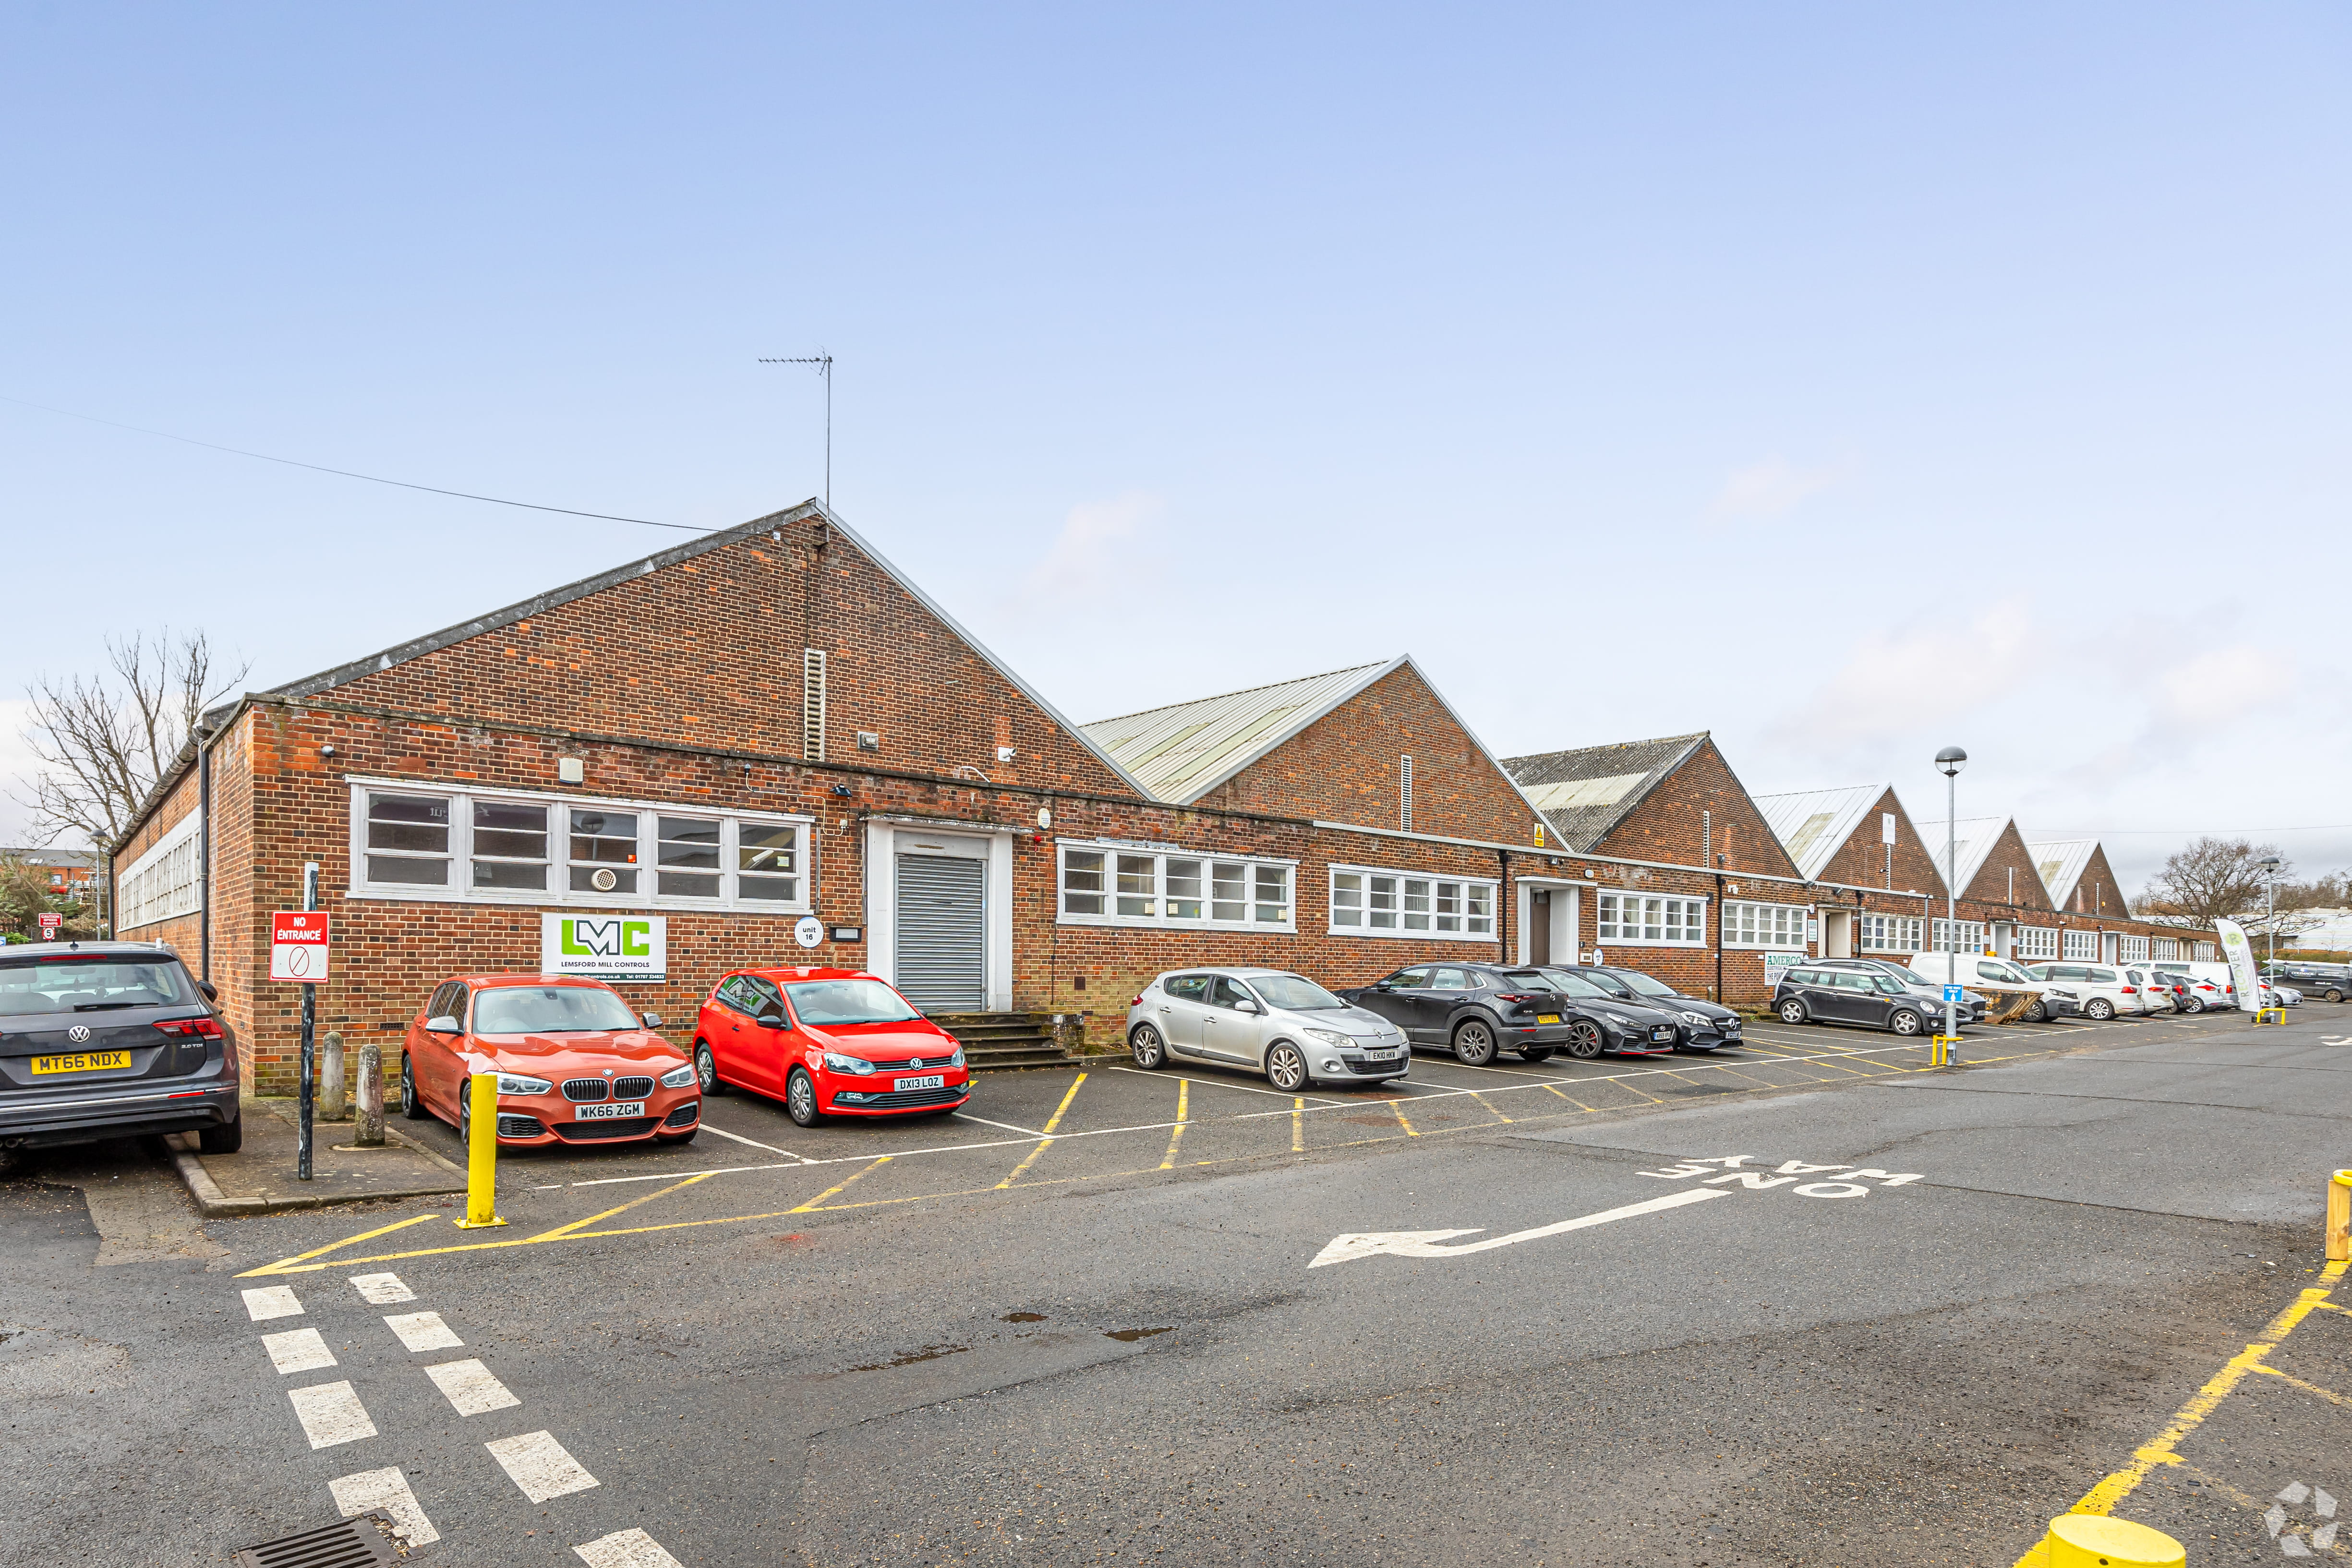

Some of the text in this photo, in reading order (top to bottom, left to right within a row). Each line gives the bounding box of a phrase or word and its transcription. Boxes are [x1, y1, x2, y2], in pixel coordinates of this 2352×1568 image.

[293, 917, 306, 927] NO
[277, 930, 321, 941] ENTRANCE
[561, 919, 650, 957] LMC
[1767, 955, 1801, 965] AMERCO
[2229, 950, 2250, 998] RECOVER
[40, 1052, 122, 1071] MT66 NDX
[900, 1077, 939, 1089] DX13 LOZ
[581, 1104, 639, 1118] WK66 ZGM
[1681, 1155, 1925, 1186] WAY
[1635, 1164, 1870, 1198] ONE
